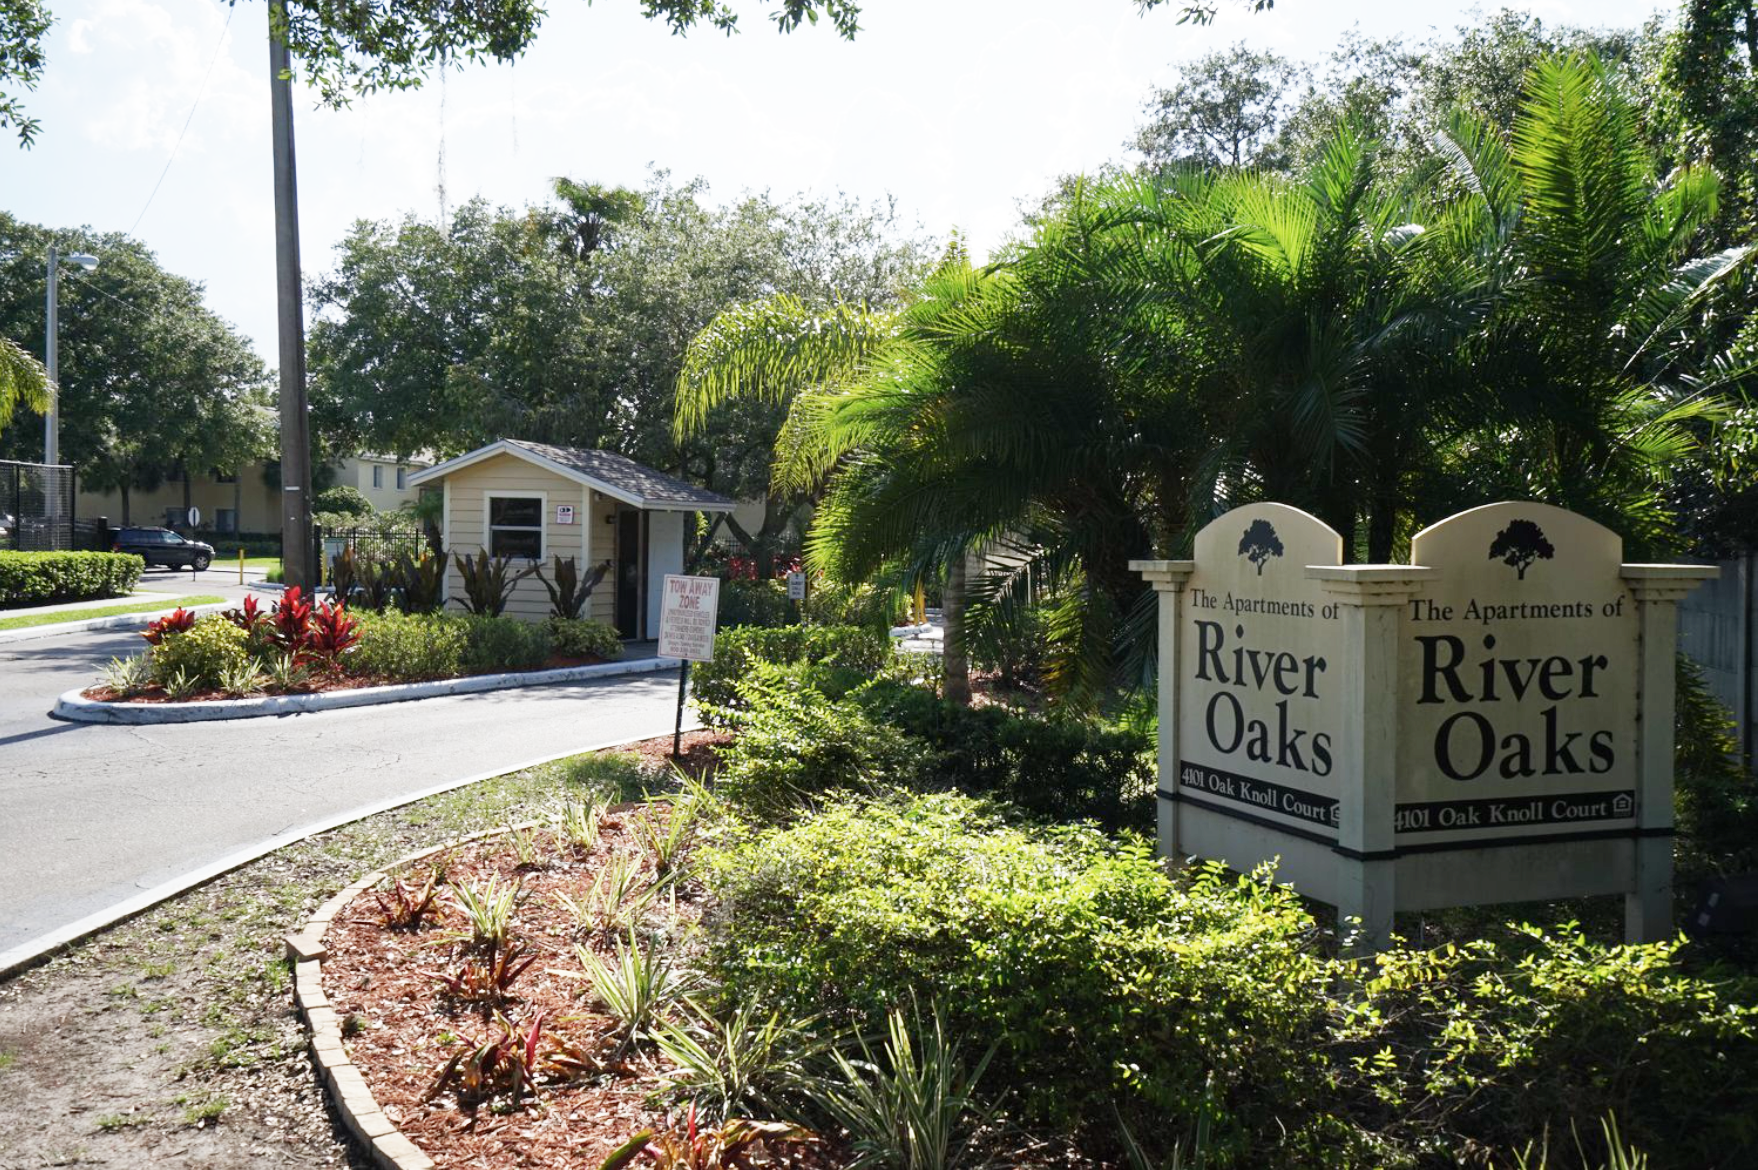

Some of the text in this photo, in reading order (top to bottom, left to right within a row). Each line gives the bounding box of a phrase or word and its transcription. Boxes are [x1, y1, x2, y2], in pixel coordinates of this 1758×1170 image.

[670, 580, 713, 596] TOW AWAY
[679, 595, 700, 609] ZONE
[1190, 588, 1340, 620] The Apartments of
[1408, 595, 1625, 625] The Apartments of
[1194, 619, 1327, 699] River
[1414, 633, 1608, 704] River
[1206, 691, 1332, 777] Oaks
[1434, 705, 1615, 781] Oaks
[1181, 767, 1326, 821] 4101 Oak Knoll Court
[1394, 800, 1607, 830] 4101 Oak Knoll Court
